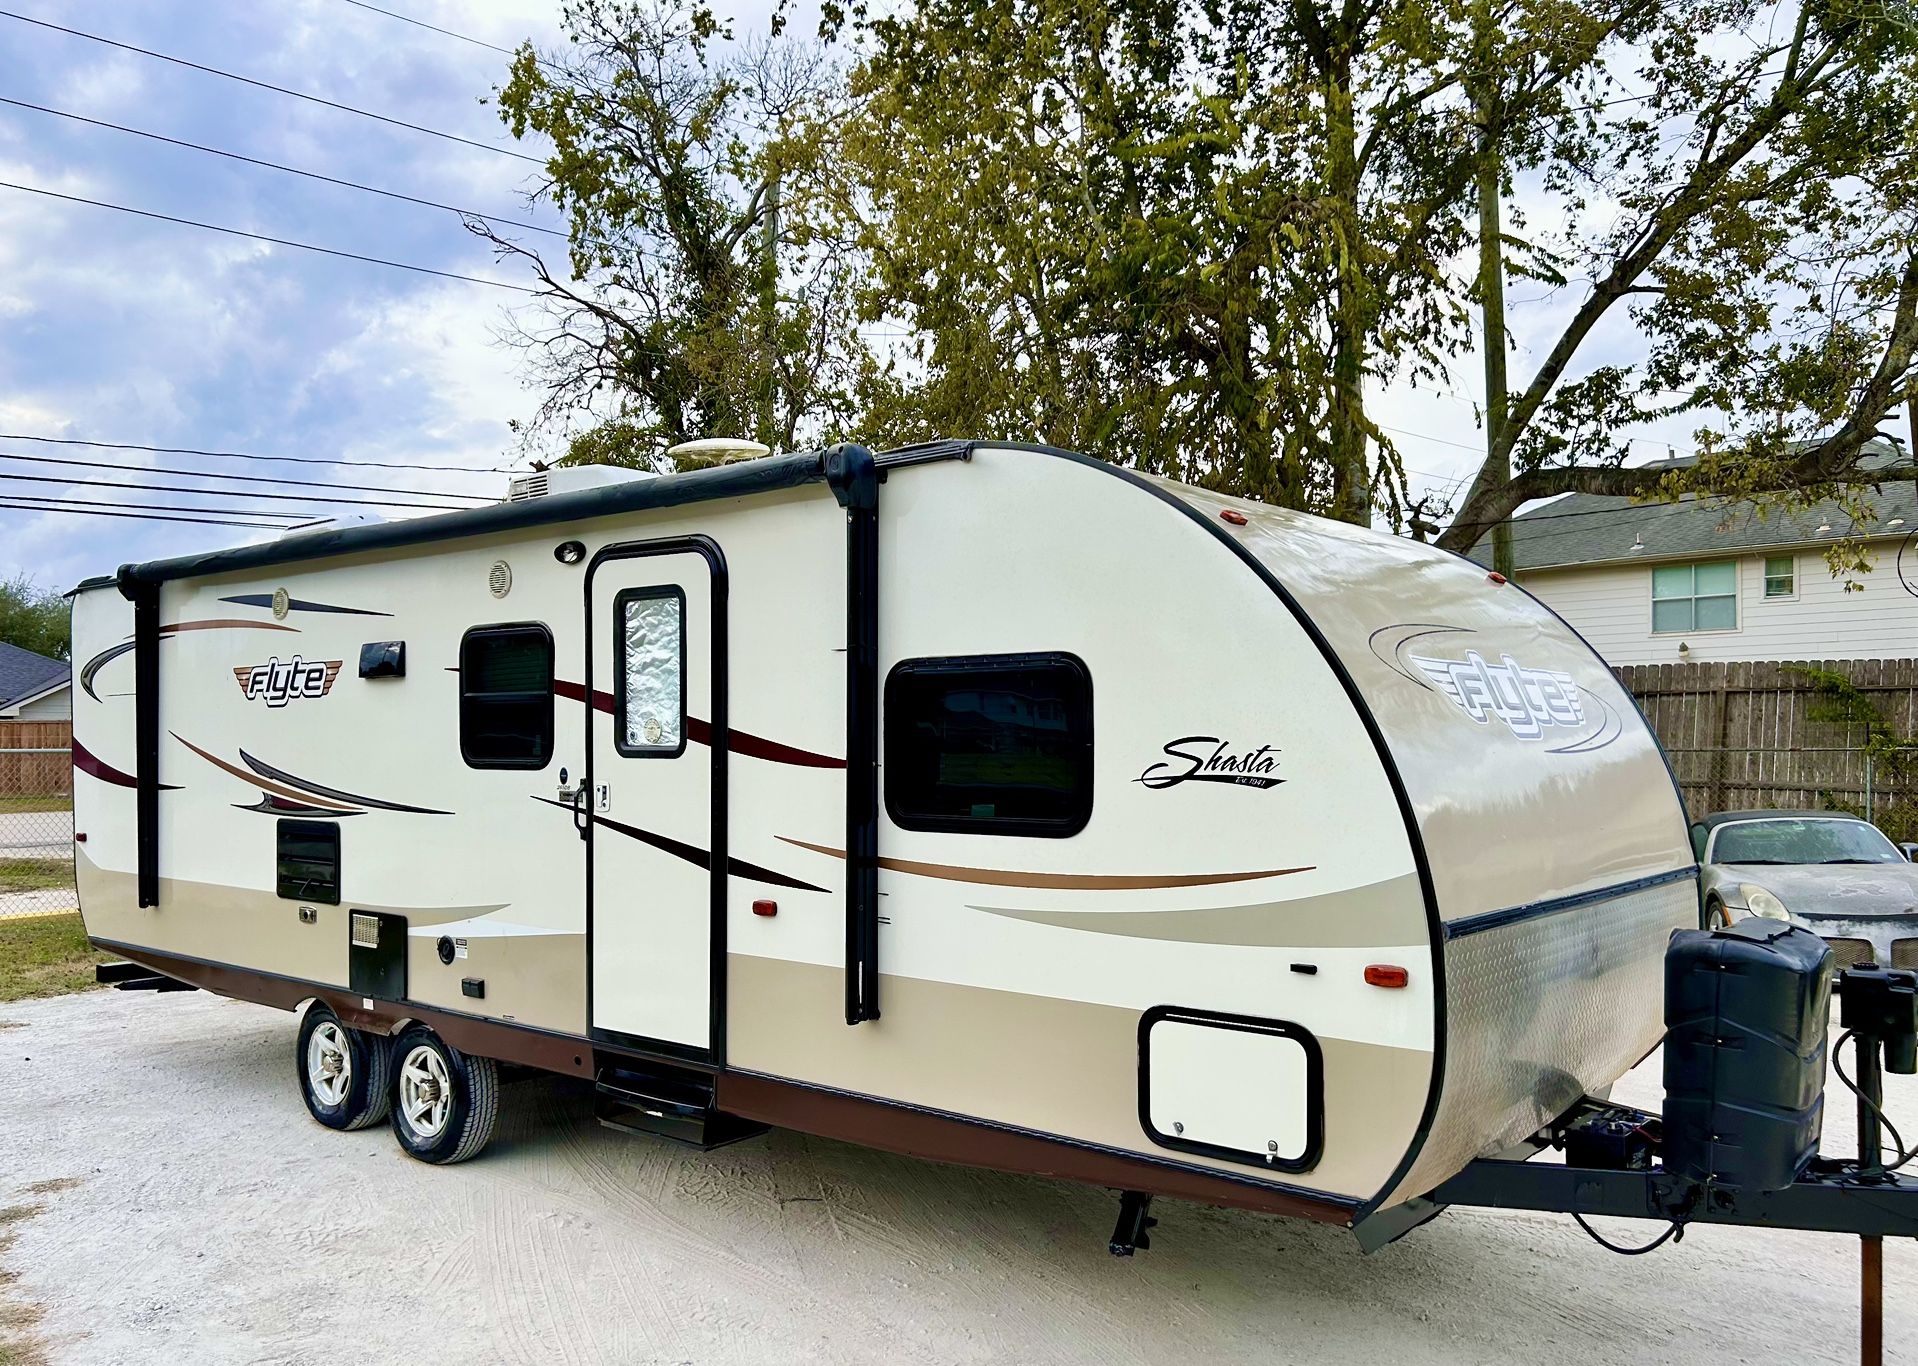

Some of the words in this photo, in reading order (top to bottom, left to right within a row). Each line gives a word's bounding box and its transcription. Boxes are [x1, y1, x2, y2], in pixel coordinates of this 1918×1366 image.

[248, 659, 325, 702] Flyte
[1452, 656, 1575, 729] Flyte
[1140, 736, 1282, 789] Shasta
